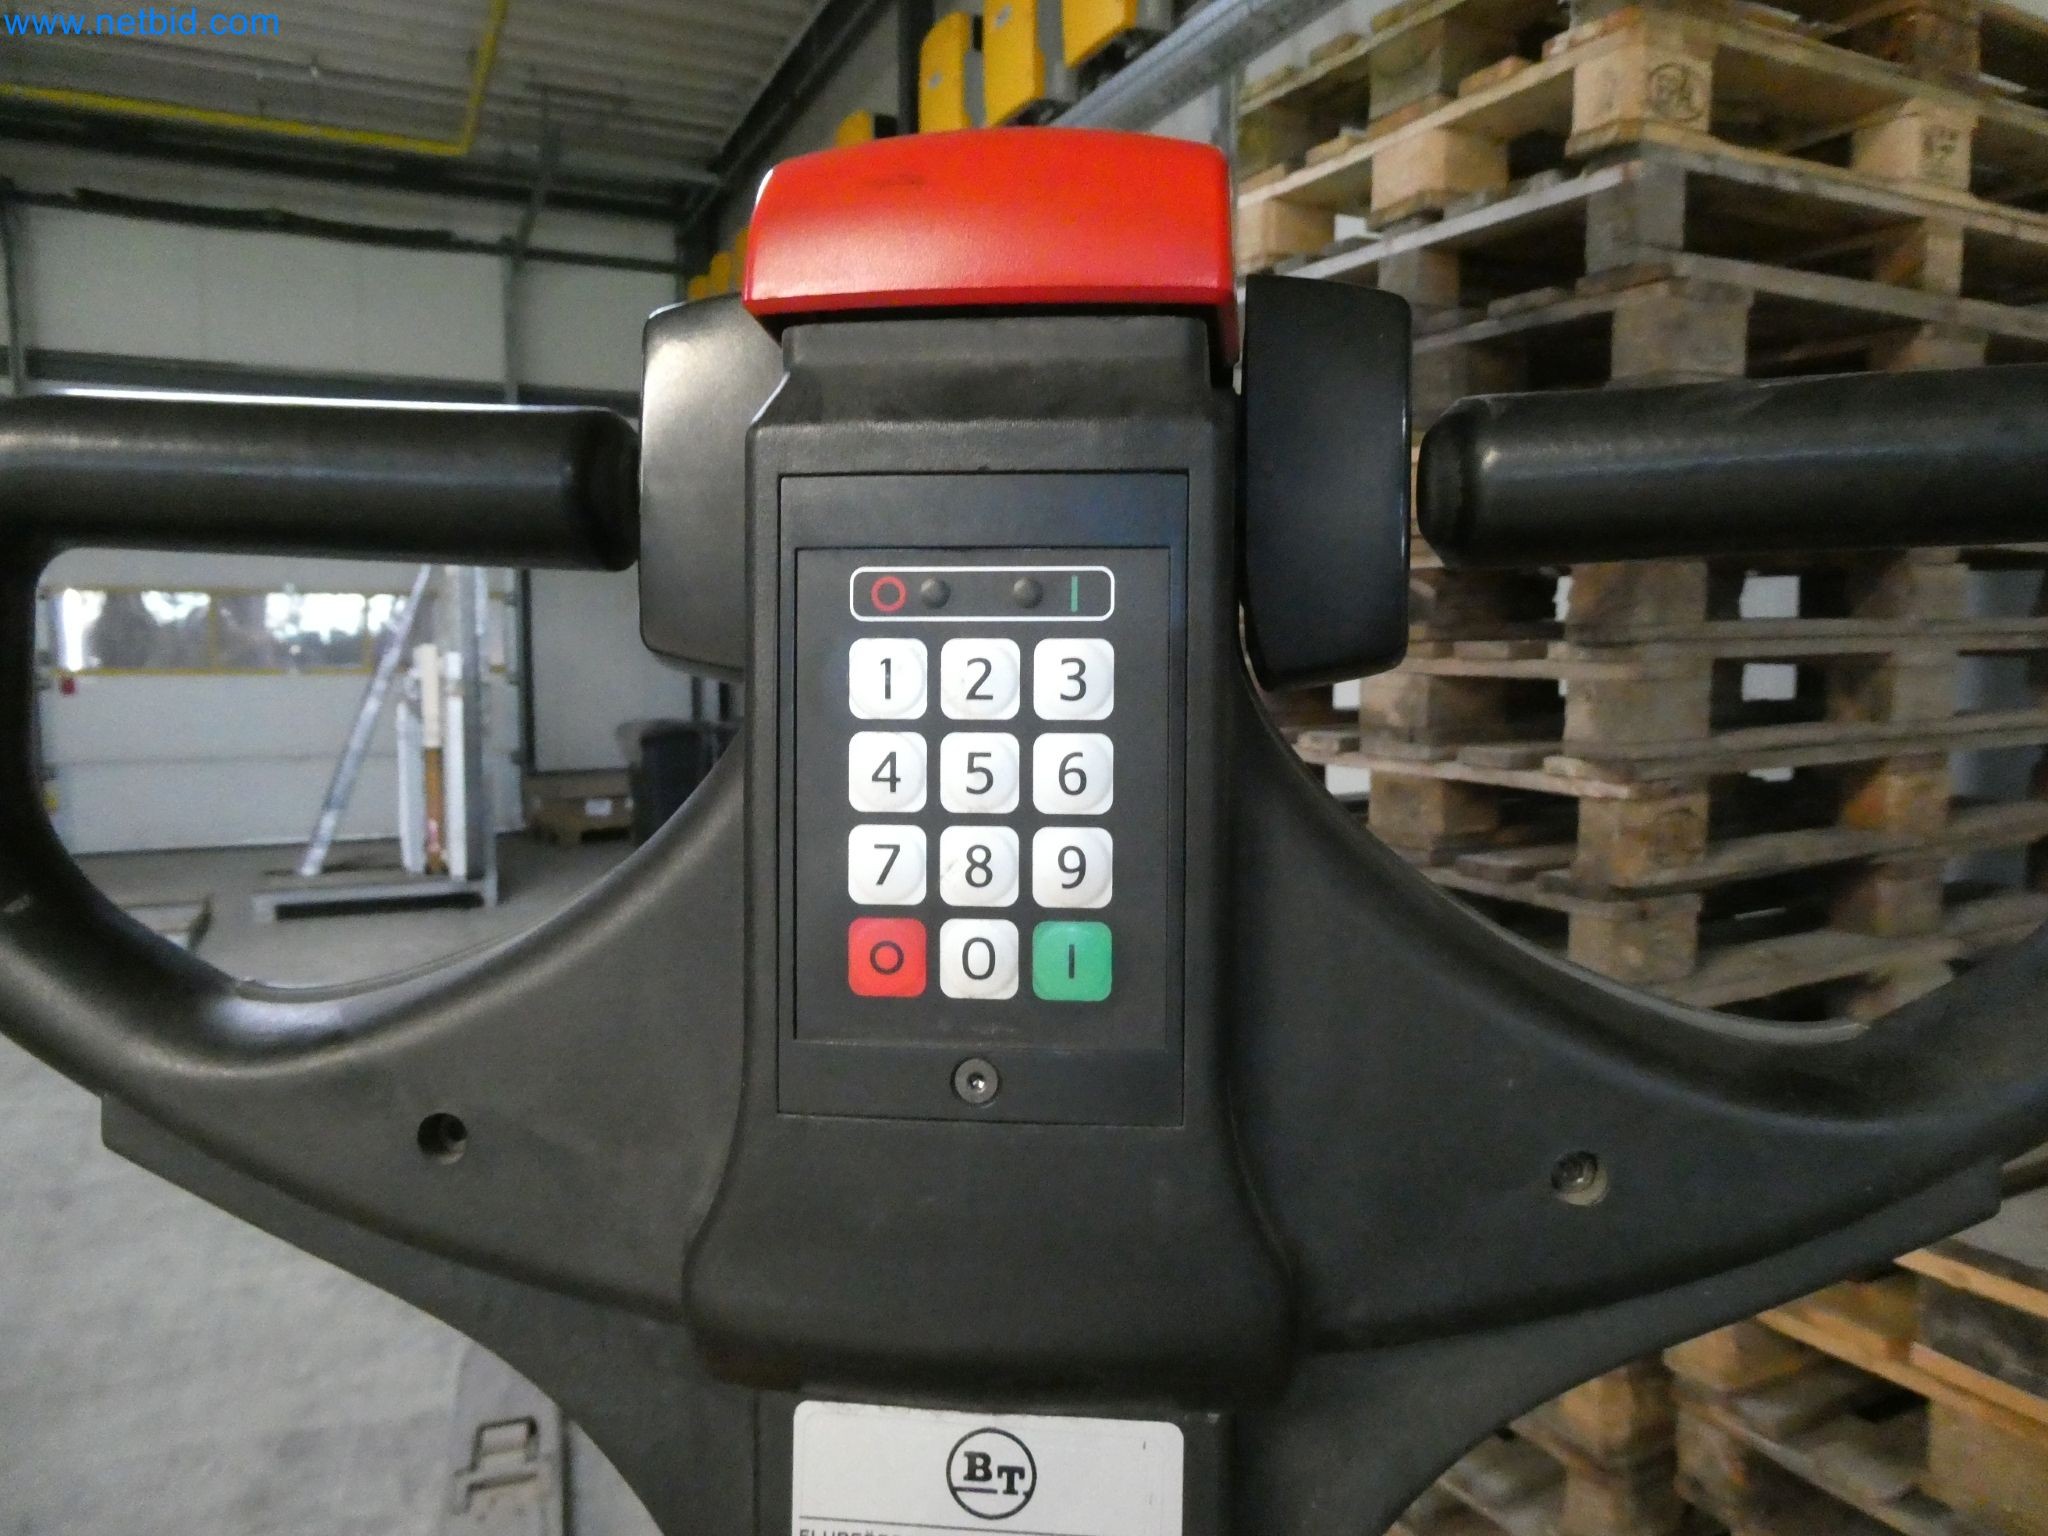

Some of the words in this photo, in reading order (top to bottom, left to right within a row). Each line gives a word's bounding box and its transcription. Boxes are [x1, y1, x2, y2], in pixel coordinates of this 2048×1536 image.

[880, 658, 892, 700] 1
[965, 657, 994, 701] 2
[1059, 657, 1088, 702] 3
[871, 751, 901, 793] 4
[965, 752, 995, 795] 5
[1058, 752, 1088, 796] 6
[874, 844, 901, 886] 7
[965, 844, 994, 888] 8
[1057, 845, 1087, 890] 9
